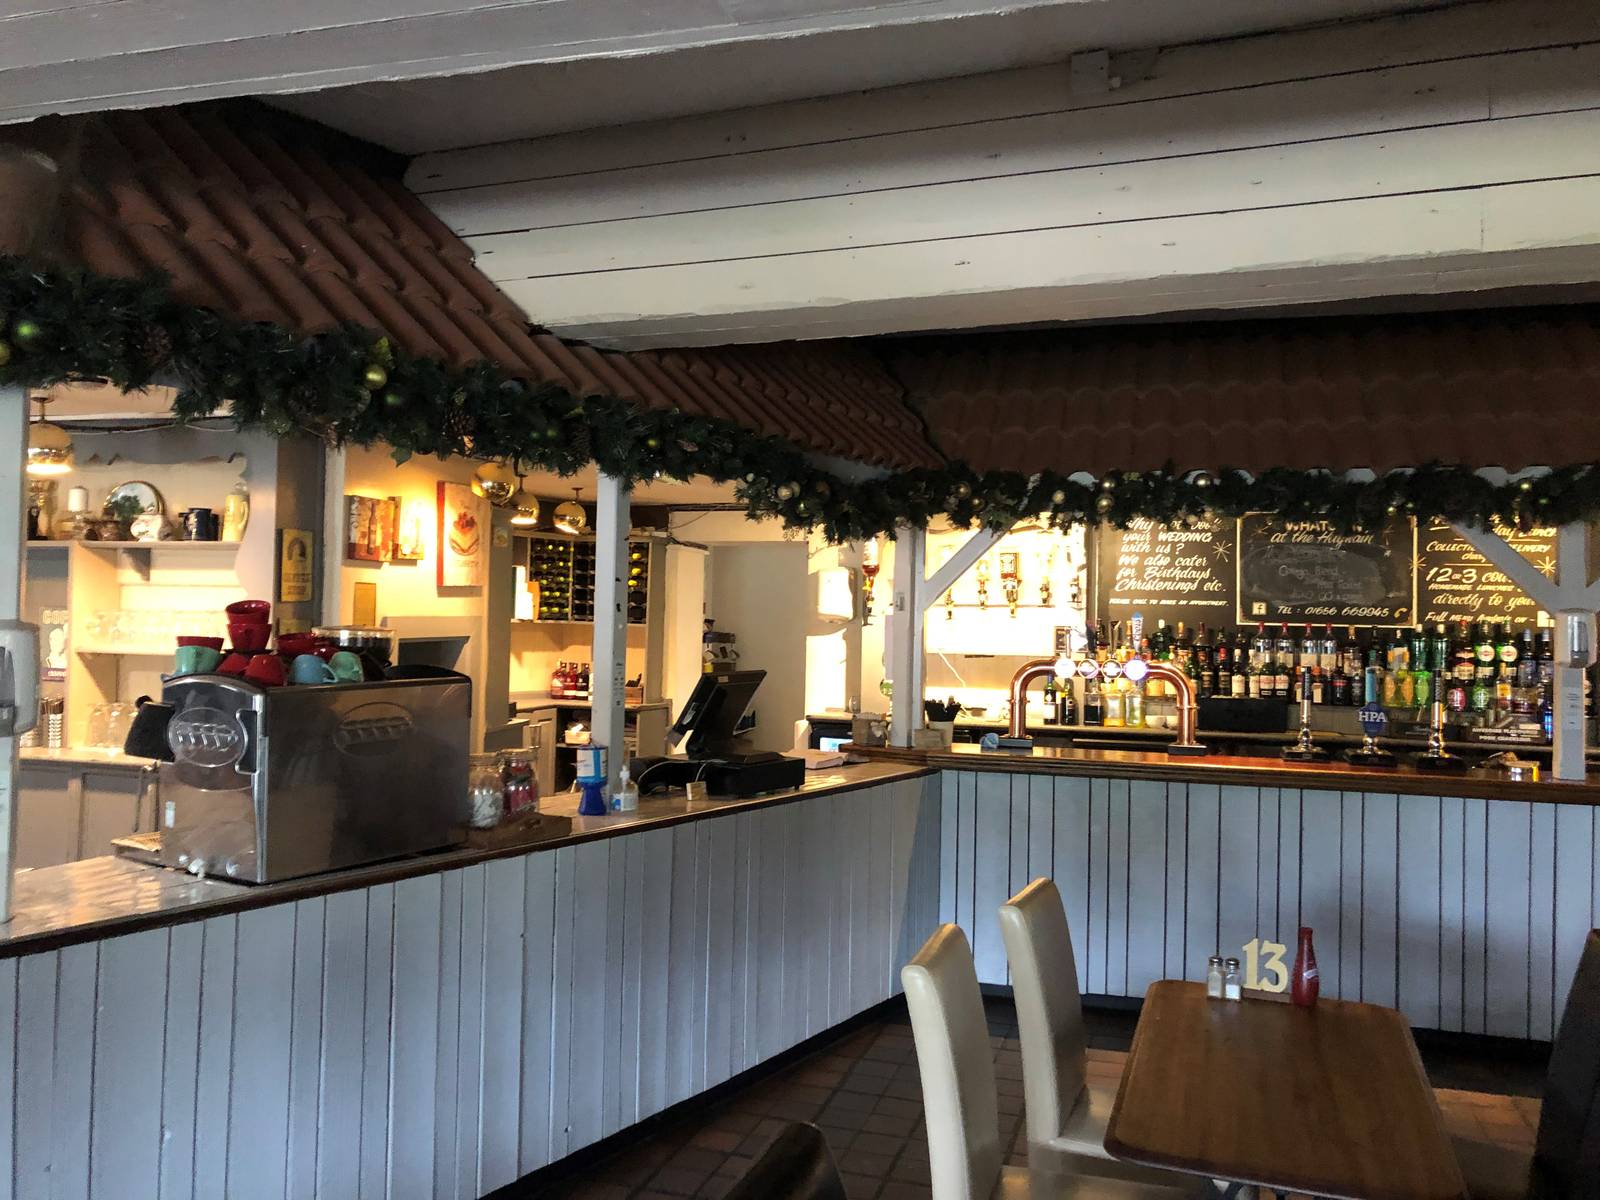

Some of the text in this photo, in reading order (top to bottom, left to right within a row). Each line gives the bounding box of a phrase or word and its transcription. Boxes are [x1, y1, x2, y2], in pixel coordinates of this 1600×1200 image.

[1122, 532, 1213, 543] your WEDDING
[1270, 532, 1287, 543] at
[1291, 531, 1314, 543] the
[1120, 541, 1152, 553] with
[1144, 554, 1170, 566] also
[1175, 555, 1208, 567] cater
[1116, 567, 1137, 581] for
[1115, 579, 1227, 594] Christenings etc.
[1433, 593, 1484, 612] directly
[1488, 593, 1504, 606] to
[1304, 606, 1337, 616] 01656
[1425, 611, 1449, 622] Full
[1358, 710, 1389, 723] HPA
[1242, 937, 1289, 994] 13
